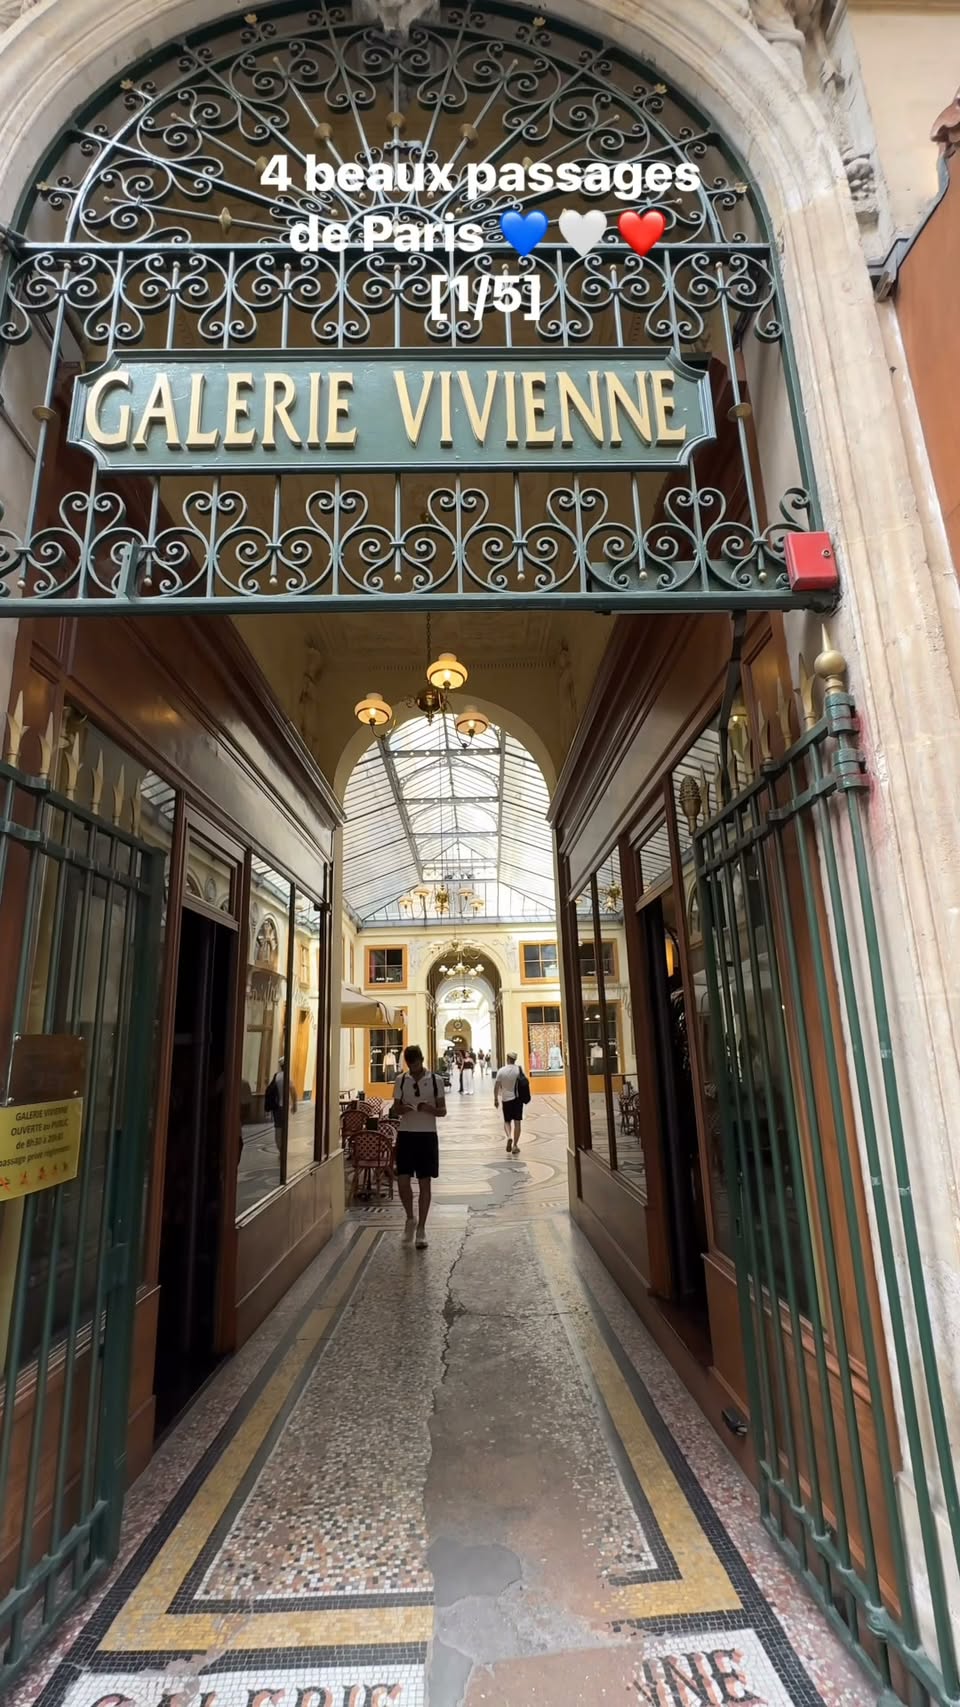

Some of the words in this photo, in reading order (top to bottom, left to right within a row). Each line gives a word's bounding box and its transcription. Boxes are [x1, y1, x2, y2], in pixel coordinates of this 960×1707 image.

[85, 370, 359, 449] GALERIE
[393, 370, 687, 448] VIVIENNE
[16, 1110, 43, 1121] GALERIE
[11, 1123, 42, 1136] OUVERTE
[16, 1141, 25, 1149] de
